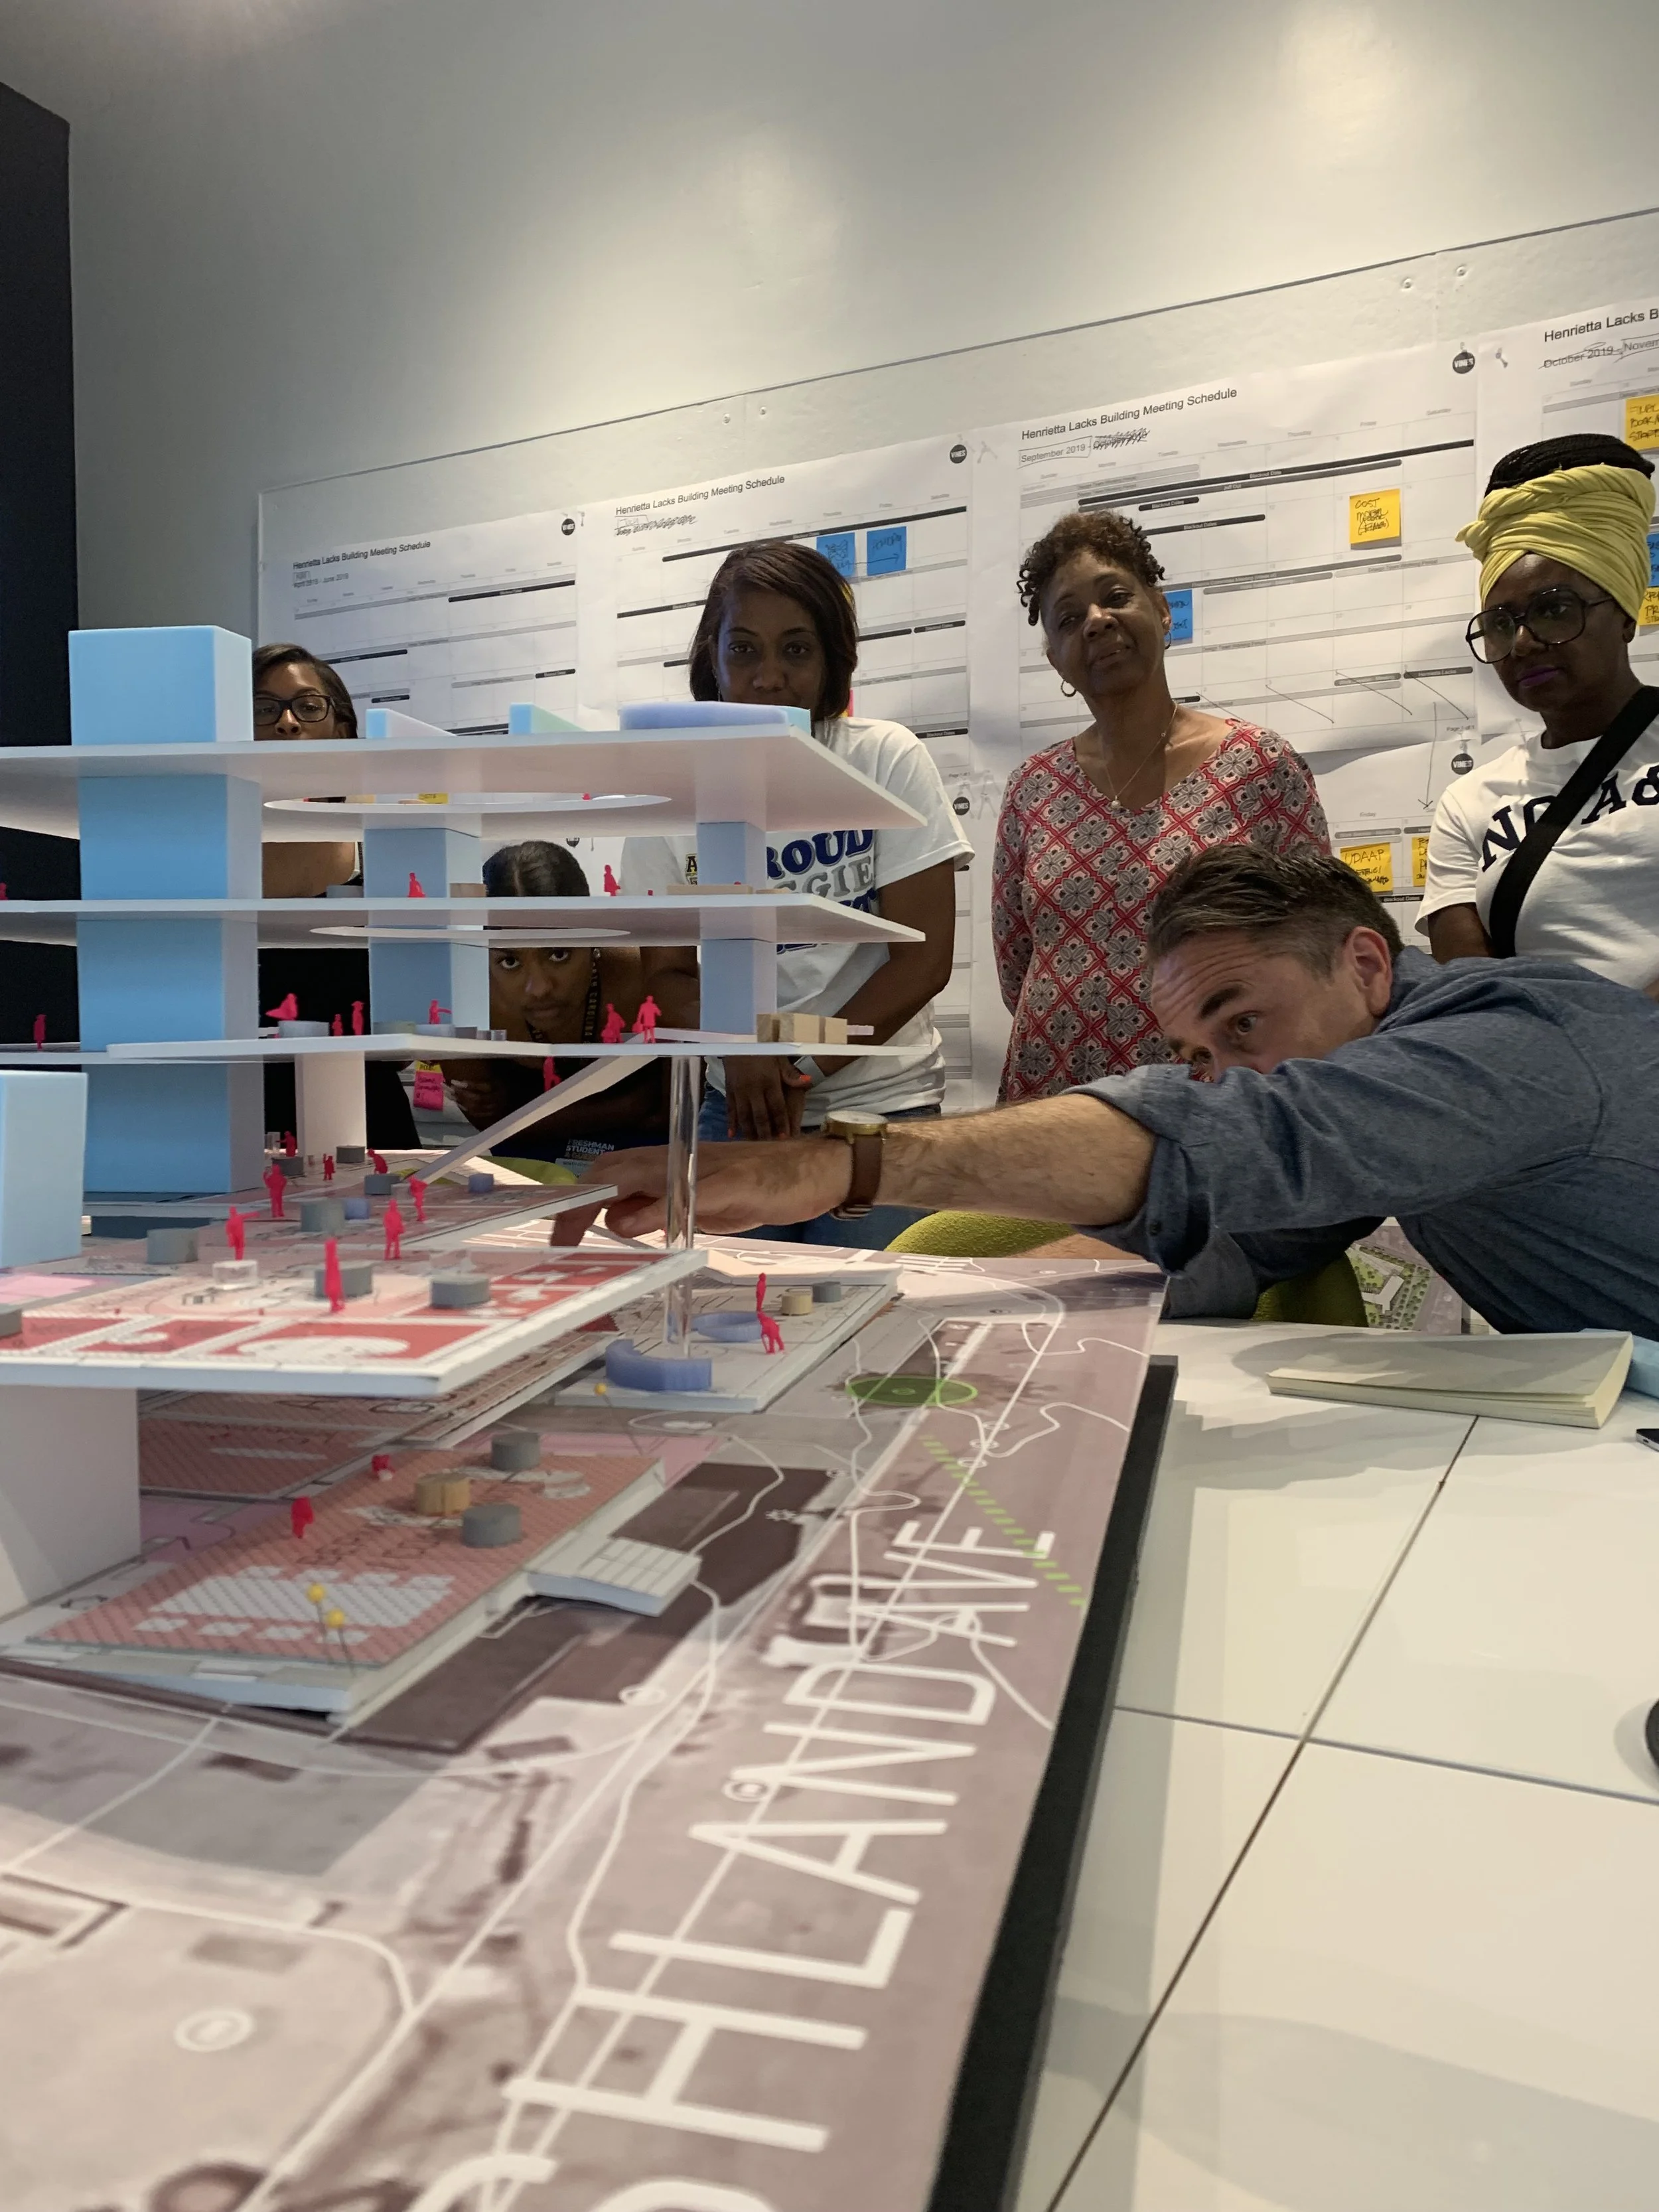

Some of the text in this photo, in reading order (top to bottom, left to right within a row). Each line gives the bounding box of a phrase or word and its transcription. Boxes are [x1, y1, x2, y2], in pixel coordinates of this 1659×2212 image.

[1544, 321, 1602, 342] Henrietta
[1607, 312, 1645, 328] Lacks
[1021, 388, 1237, 440] Henrietta Lacks Building Meeting Schedule
[1021, 448, 1063, 463] September
[1066, 444, 1086, 455] 2019
[616, 475, 785, 515] Henrietta Lacks Building Meeting Schedule
[1355, 498, 1380, 509] COST
[293, 540, 431, 569] Henrietta Lacks Building Meeting Schedule
[566, 1145, 605, 1155] STUDENT
[405, 1520, 1055, 2212] HLAND AVE
